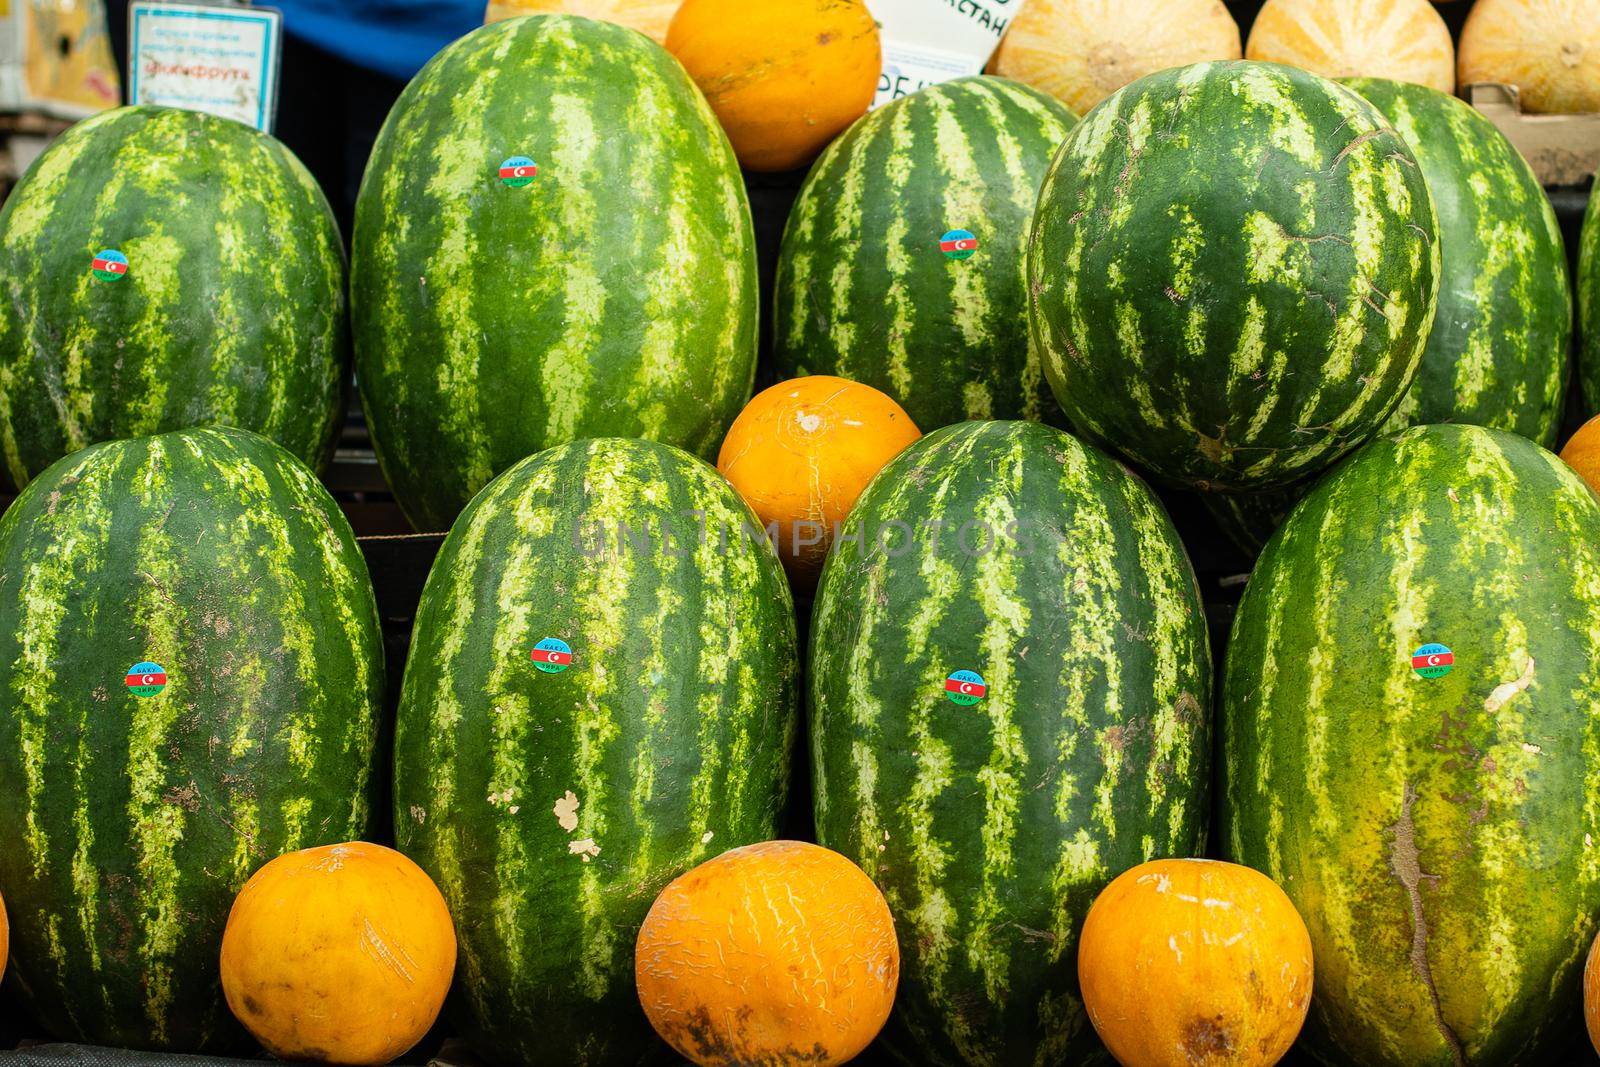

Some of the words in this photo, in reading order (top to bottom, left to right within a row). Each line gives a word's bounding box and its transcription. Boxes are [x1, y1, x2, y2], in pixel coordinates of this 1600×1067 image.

[544, 643, 564, 652] БАКУ
[1421, 647, 1442, 655] БАКУ
[541, 663, 560, 671] ЗИРА
[957, 674, 976, 683] БАКУ
[954, 694, 972, 702] ЗИРА
